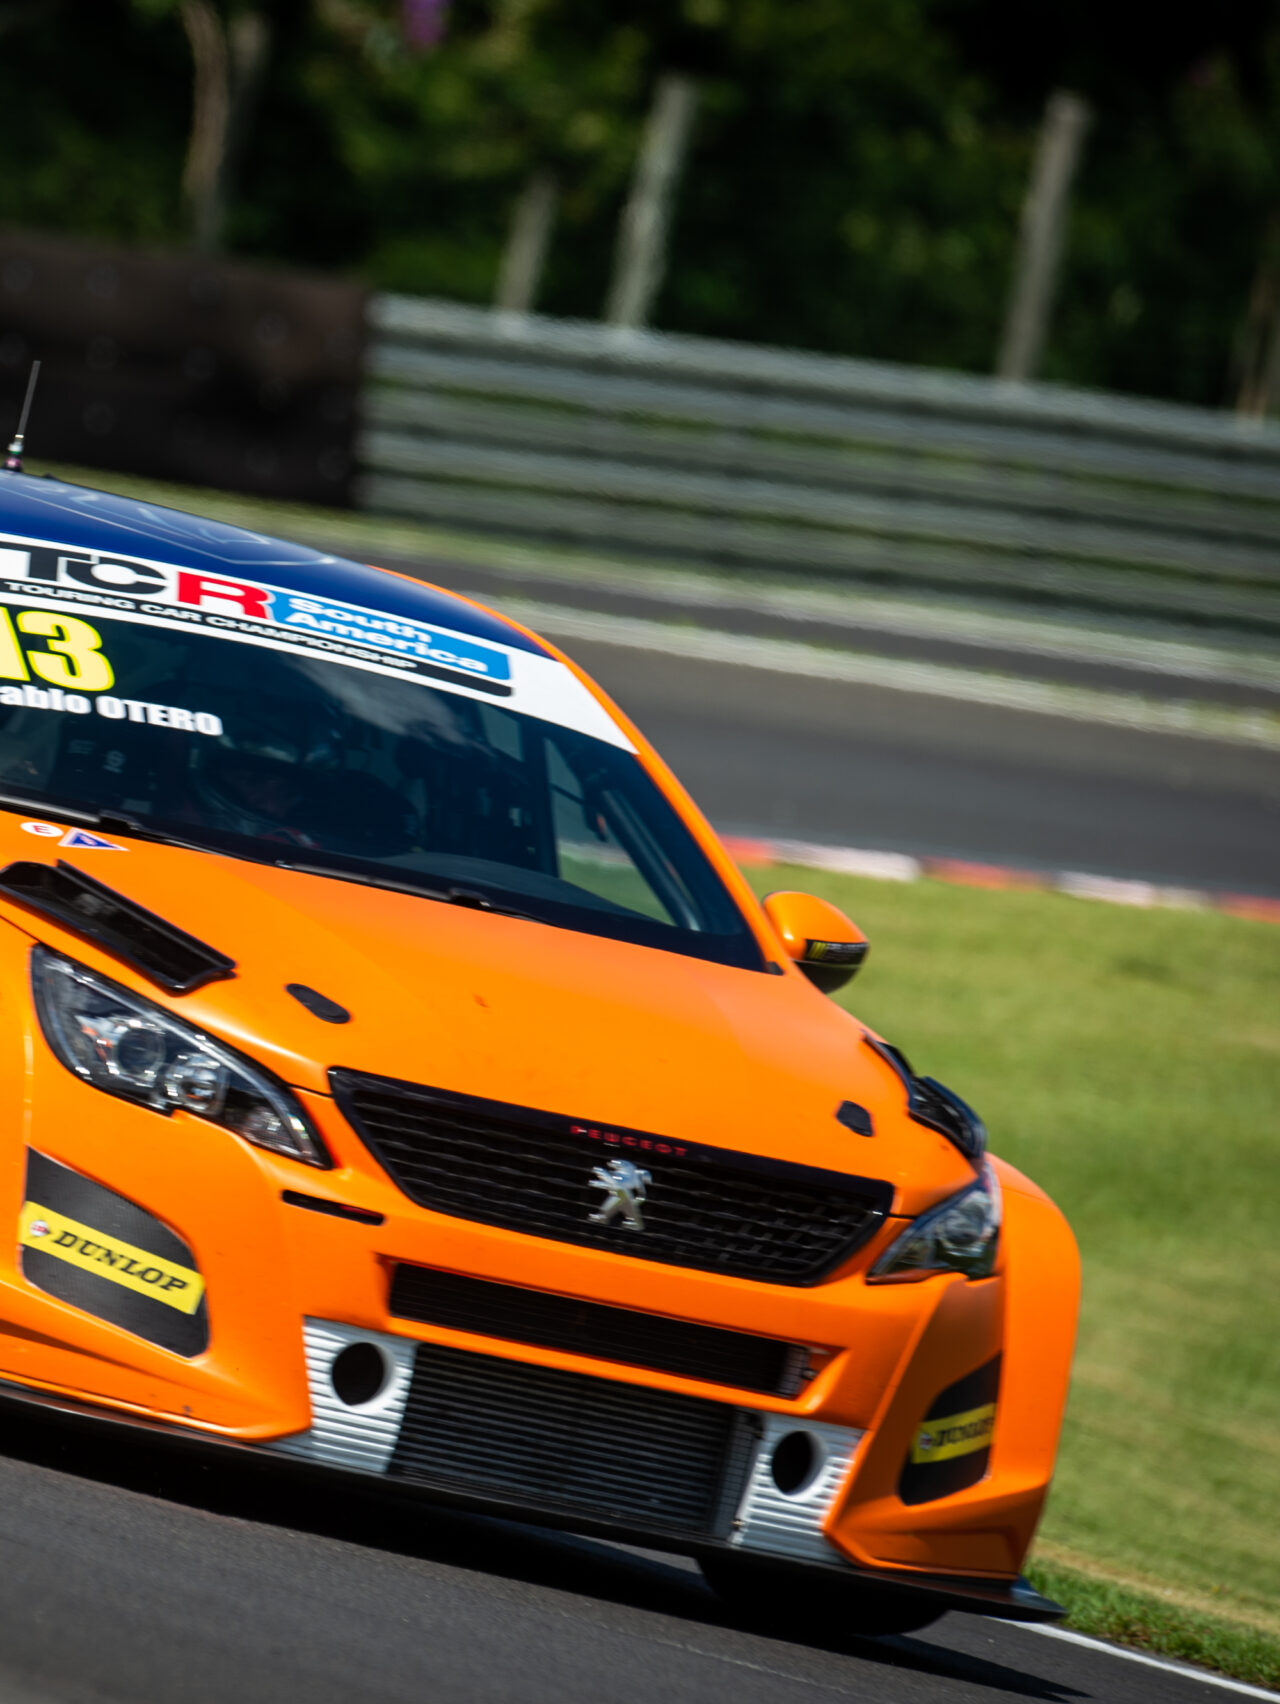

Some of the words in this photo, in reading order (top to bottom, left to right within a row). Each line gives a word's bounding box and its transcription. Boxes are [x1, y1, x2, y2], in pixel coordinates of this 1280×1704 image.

[3, 581, 137, 610] TOURING
[140, 602, 203, 624] CAR
[205, 615, 419, 670] CHAMPIONSHIP
[284, 612, 489, 673] America
[287, 597, 433, 643] South
[95, 695, 224, 737] OTERO
[570, 1125, 688, 1158] PEUGEOT
[53, 1230, 189, 1292] DUNLOP
